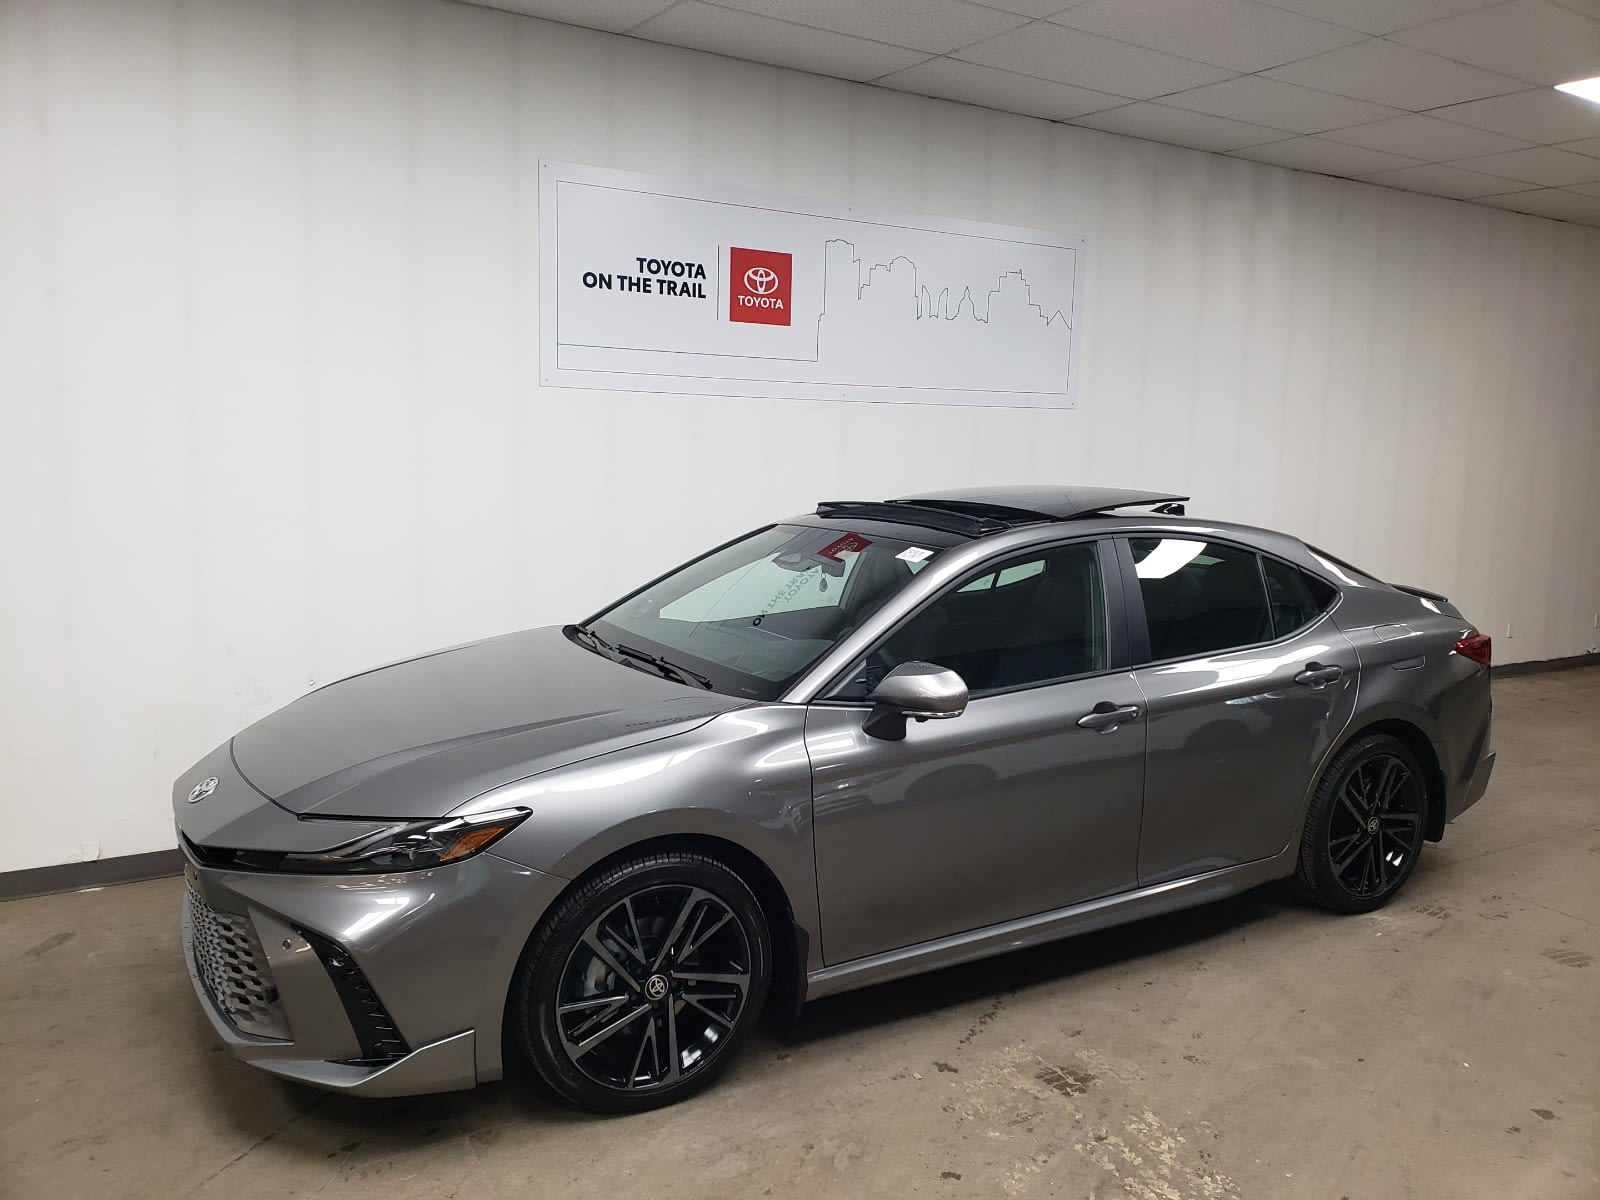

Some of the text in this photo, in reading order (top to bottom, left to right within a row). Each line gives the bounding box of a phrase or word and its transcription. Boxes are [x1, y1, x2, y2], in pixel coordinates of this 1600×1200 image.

[636, 257, 707, 280] TOYOTA
[582, 272, 707, 299] ON THE TRAIL
[737, 295, 784, 310] TOYOTA
